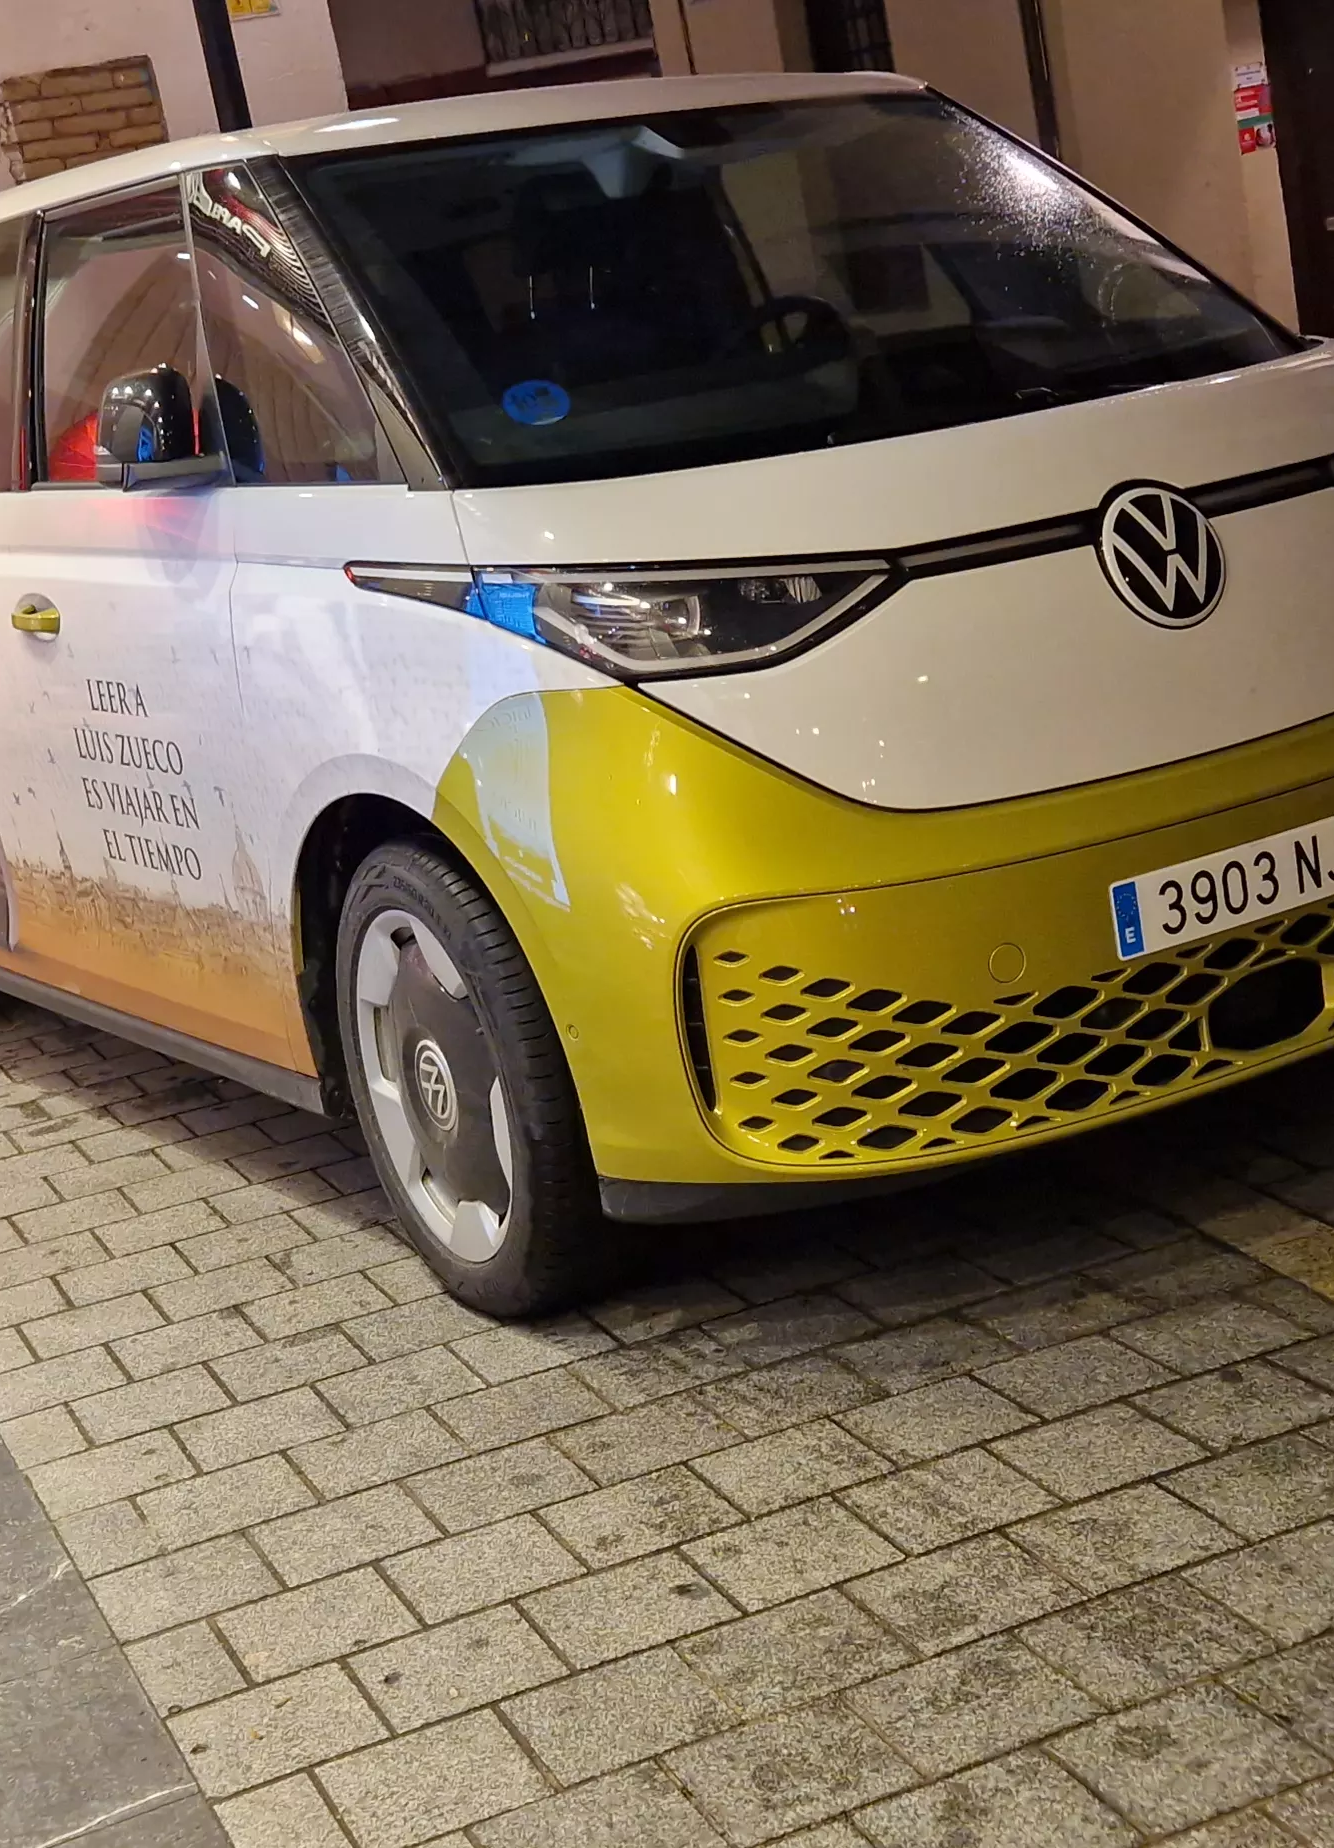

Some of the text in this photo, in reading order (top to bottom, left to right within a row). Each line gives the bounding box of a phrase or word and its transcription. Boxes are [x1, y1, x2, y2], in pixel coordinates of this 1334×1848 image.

[1108, 489, 1215, 616] VW
[86, 678, 150, 718] LEER A
[73, 727, 184, 776] LUIS ZUECO
[81, 777, 201, 830] ES VIAJAR EN
[102, 828, 202, 881] EL TIEMPO
[1125, 926, 1136, 944] E
[1158, 851, 1280, 935] 3903
